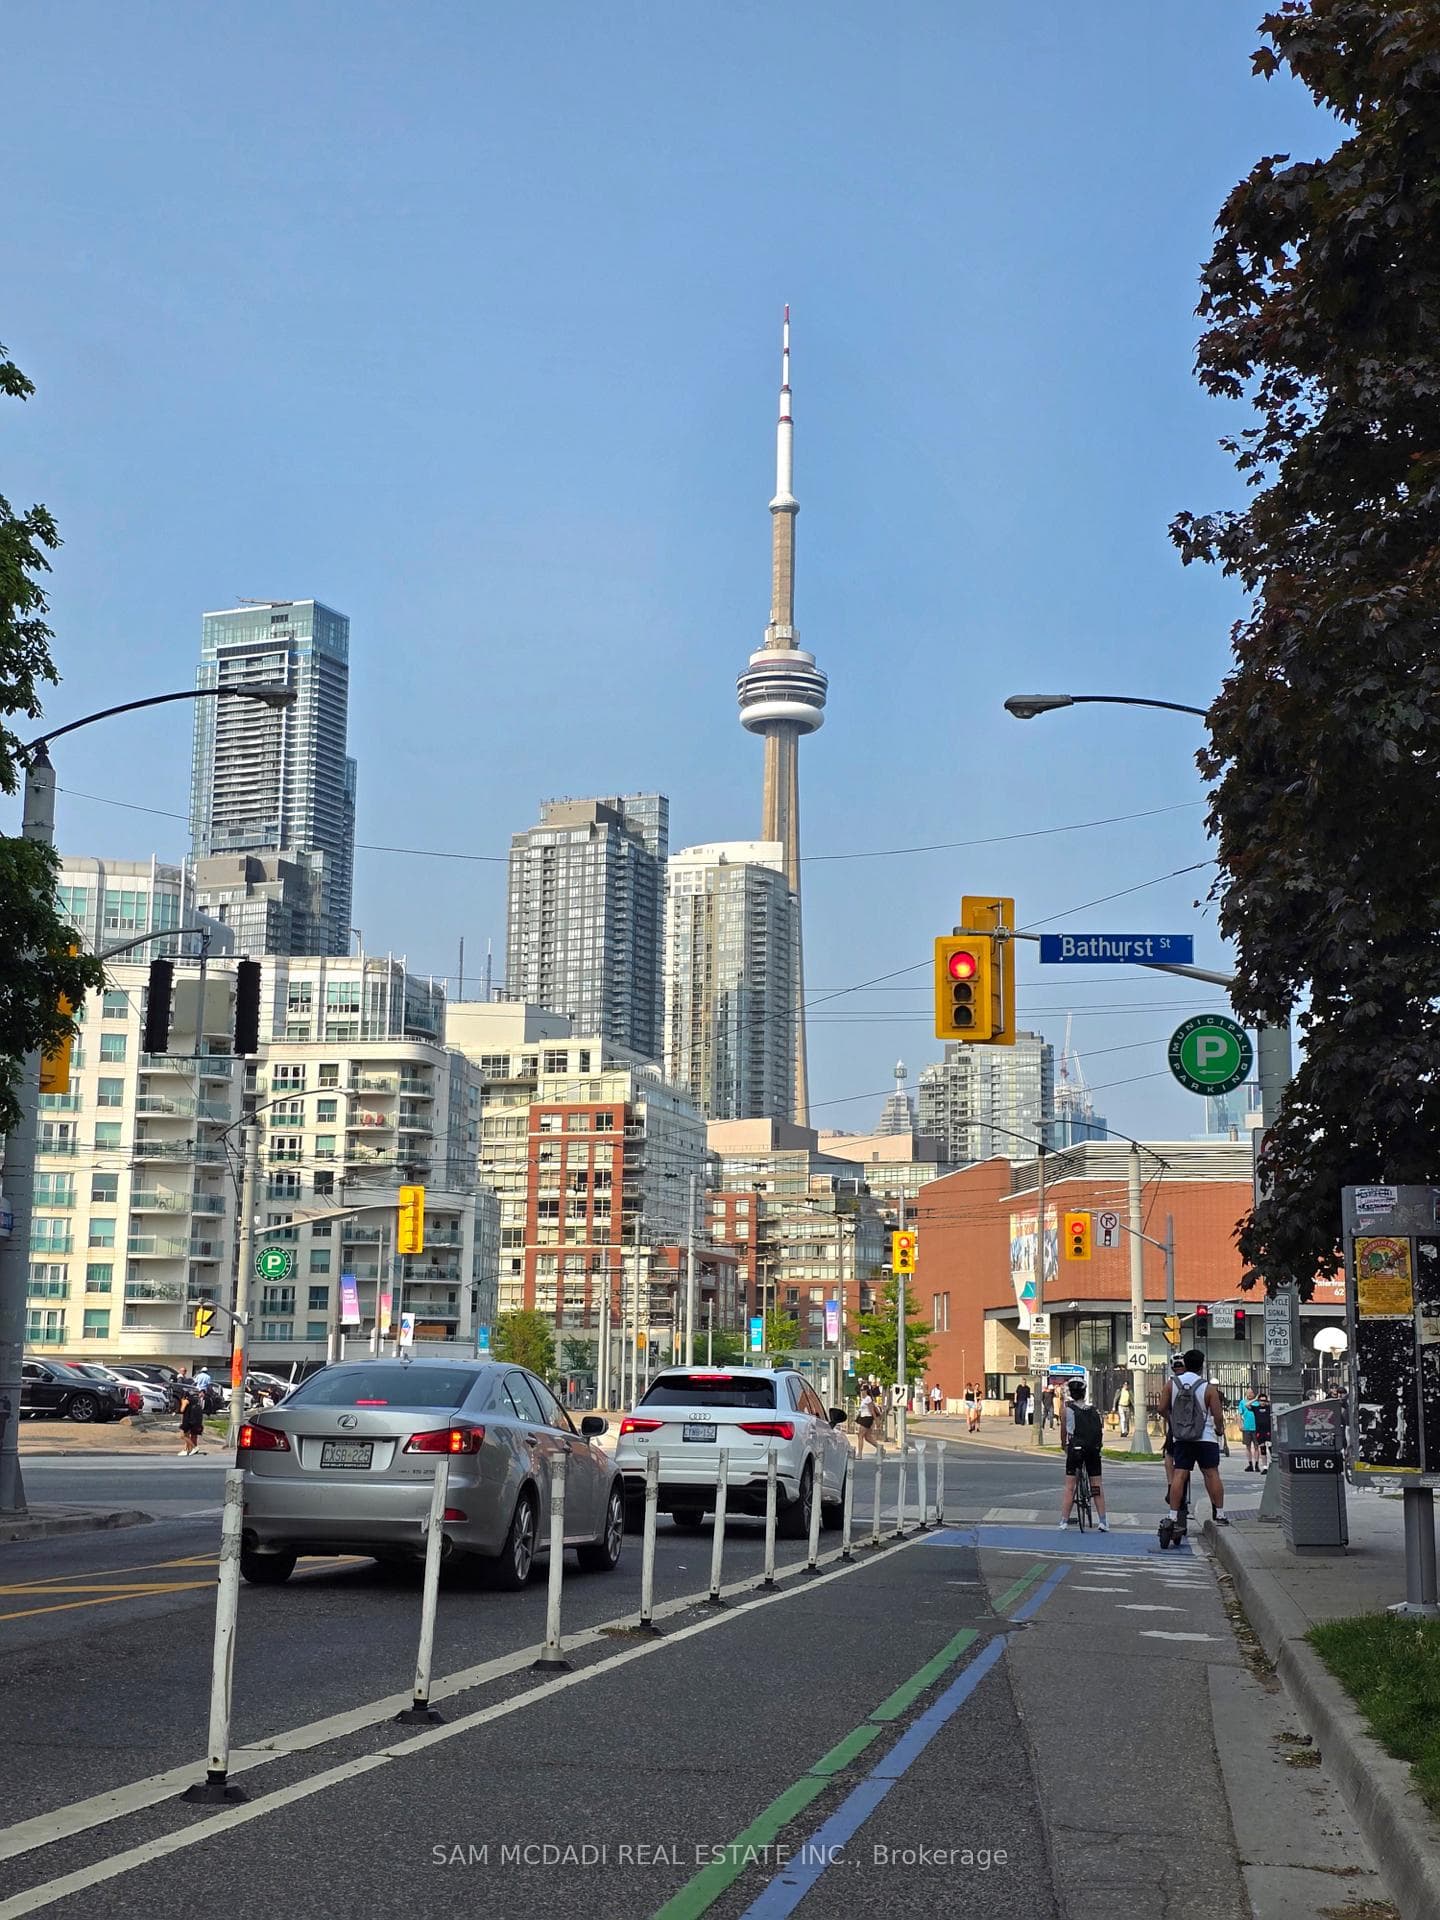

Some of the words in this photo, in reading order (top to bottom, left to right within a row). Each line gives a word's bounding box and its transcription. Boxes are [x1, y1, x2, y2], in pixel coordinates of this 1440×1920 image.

[1061, 936, 1154, 957] Bathurst
[1160, 937, 1171, 949] St
[1172, 1017, 1248, 1052] MUNICIPAL
[1196, 1035, 1228, 1067] P
[1172, 1062, 1249, 1093] PARKING
[267, 1255, 282, 1270] P
[1267, 1309, 1287, 1317] SIGNAL
[1215, 1316, 1233, 1325] SIGNAL
[1267, 1338, 1289, 1346] YIELD
[1129, 1353, 1147, 1366] 40
[1295, 1456, 1320, 1469] Litter
